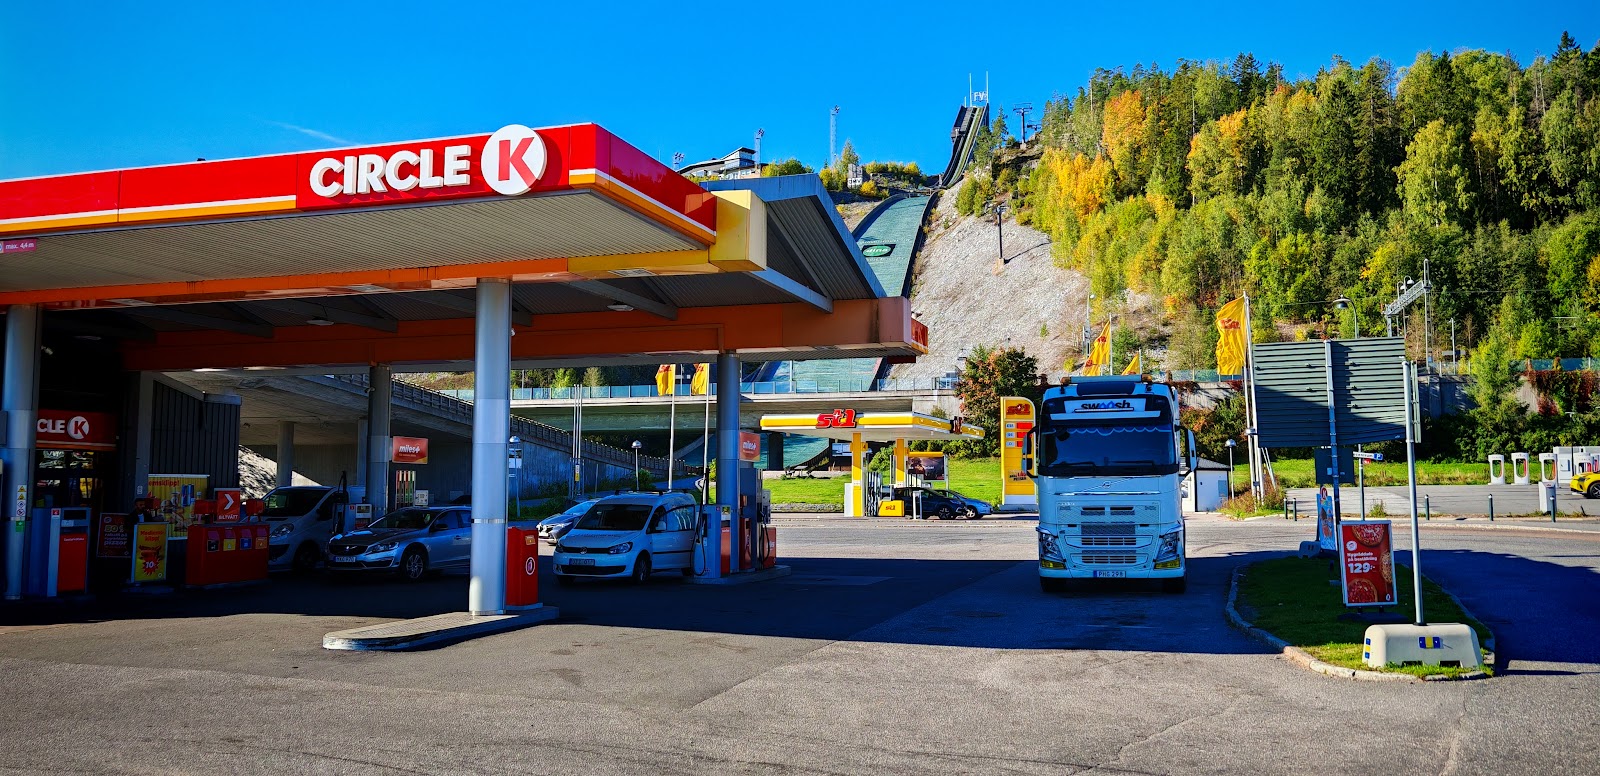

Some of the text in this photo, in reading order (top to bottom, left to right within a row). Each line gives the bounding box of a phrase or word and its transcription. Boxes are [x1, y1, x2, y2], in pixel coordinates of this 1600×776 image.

[309, 135, 541, 198] CIRCLE K
[37, 418, 65, 434] CLE
[816, 408, 856, 429] st1
